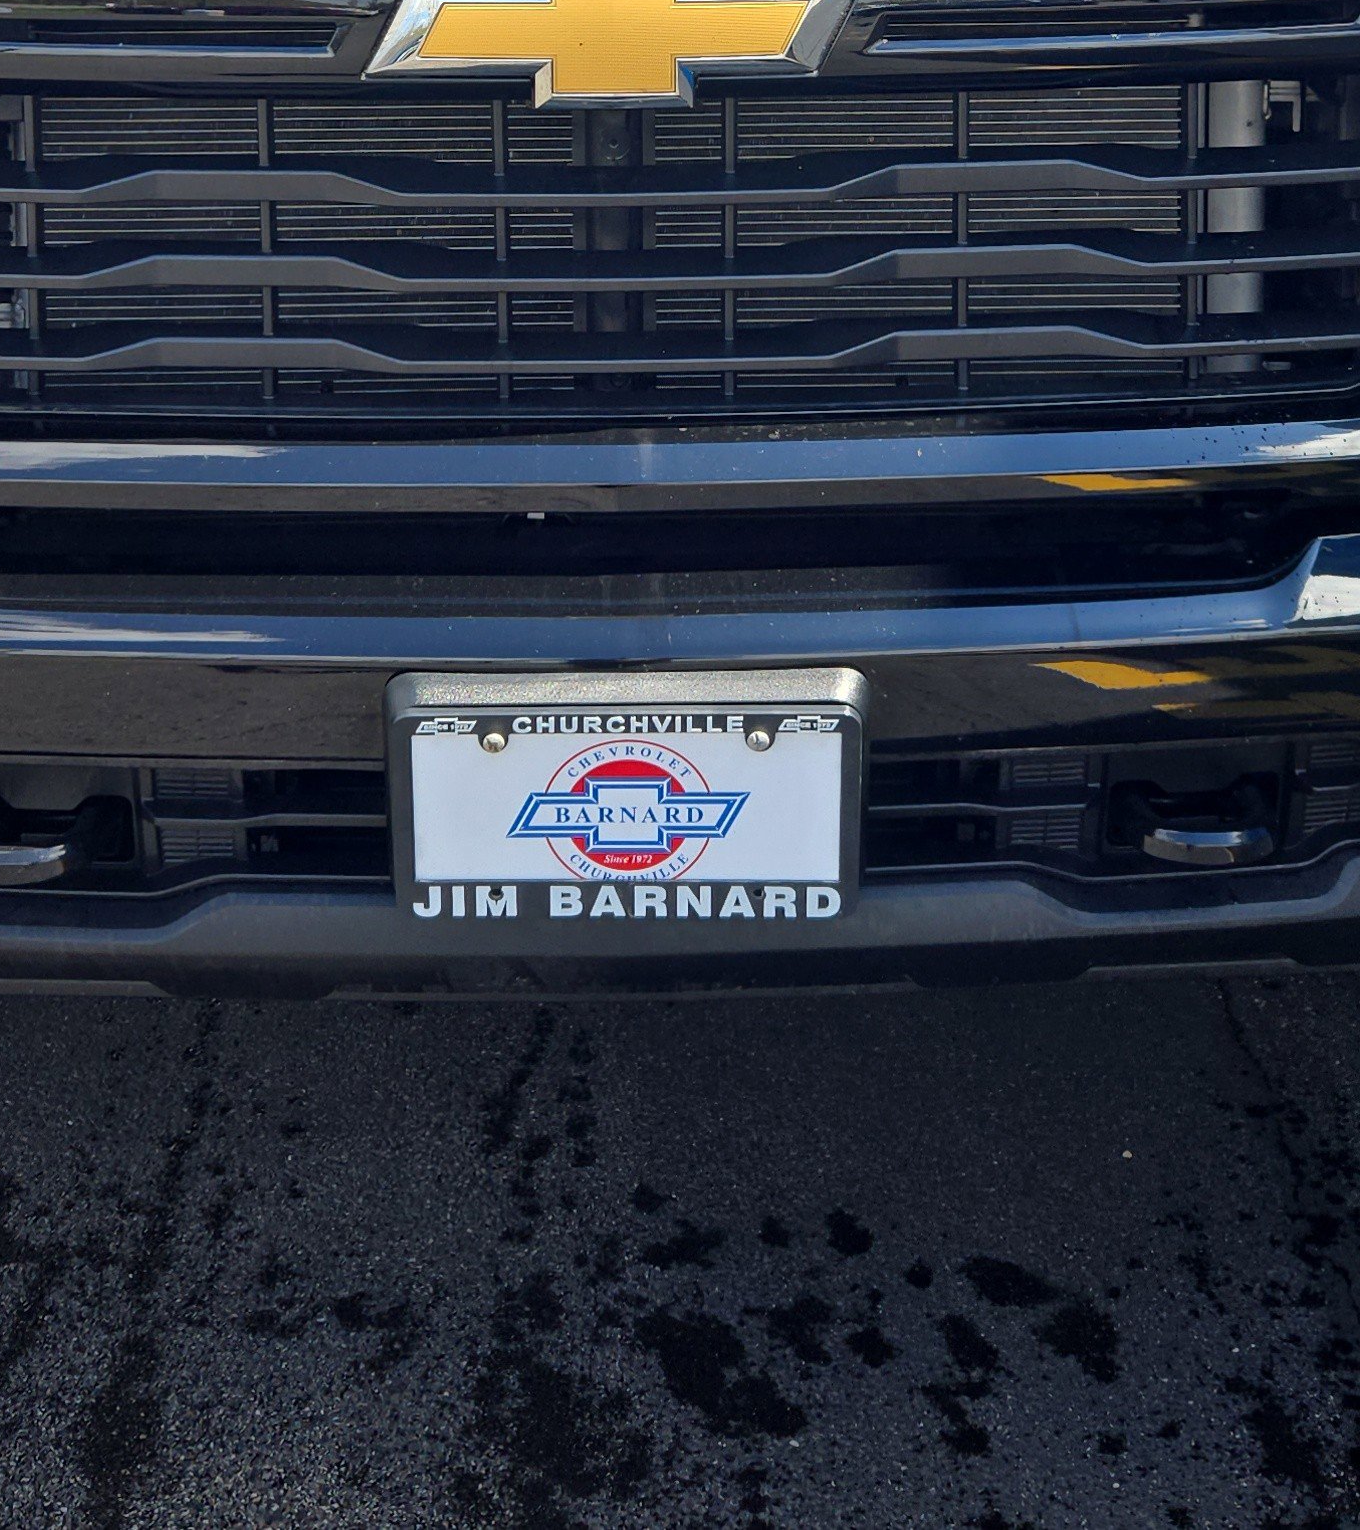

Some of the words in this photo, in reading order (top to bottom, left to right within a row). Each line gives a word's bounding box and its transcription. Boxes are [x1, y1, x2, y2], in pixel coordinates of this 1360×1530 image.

[512, 715, 745, 734] CHURCHVILLE
[567, 745, 692, 779] CHEVROLET
[554, 806, 704, 823] BARNARD
[603, 854, 630, 864] Since
[631, 854, 653, 864] 1972
[412, 885, 518, 918] JIM
[549, 885, 841, 918] BARNARD
